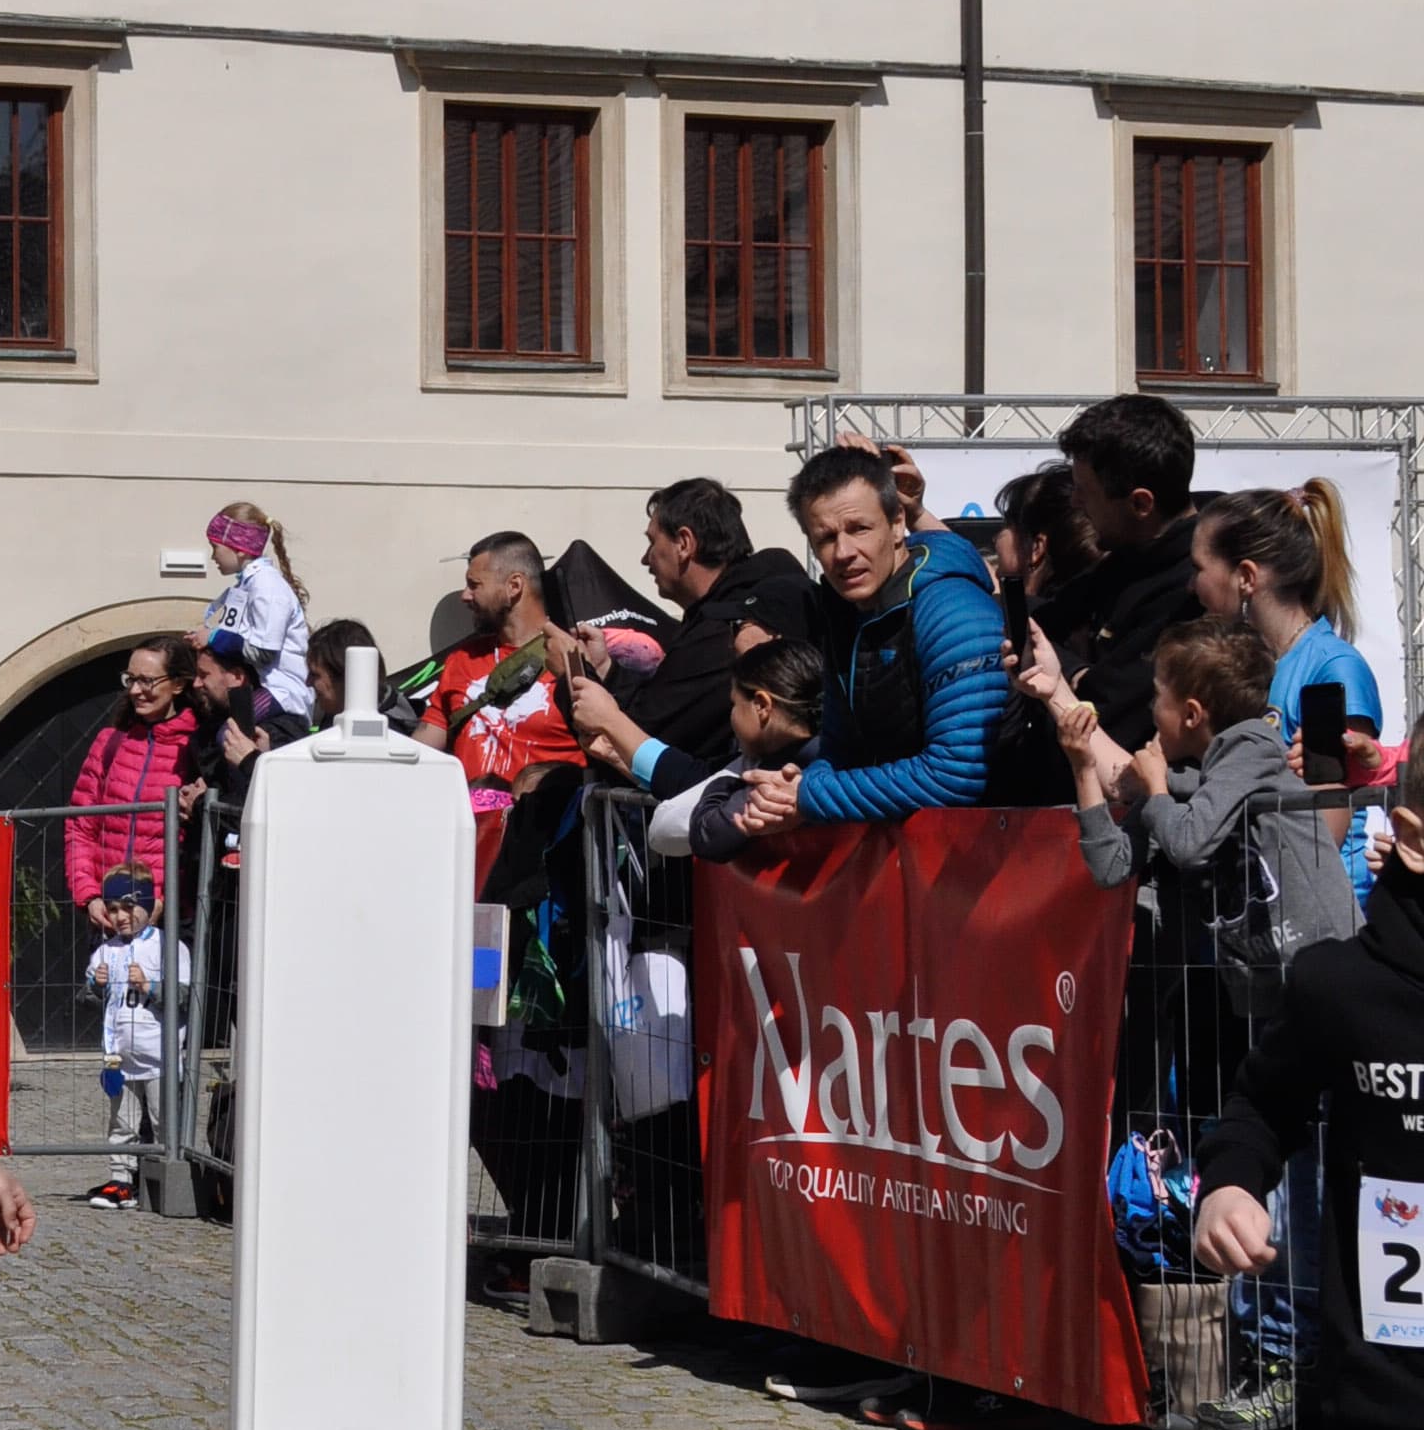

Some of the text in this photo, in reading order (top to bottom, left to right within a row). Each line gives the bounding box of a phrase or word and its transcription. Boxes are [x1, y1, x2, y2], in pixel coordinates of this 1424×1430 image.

[739, 946, 1065, 1170] Nartes
[1352, 1060, 1424, 1100] BEST
[767, 1157, 794, 1191] TOP
